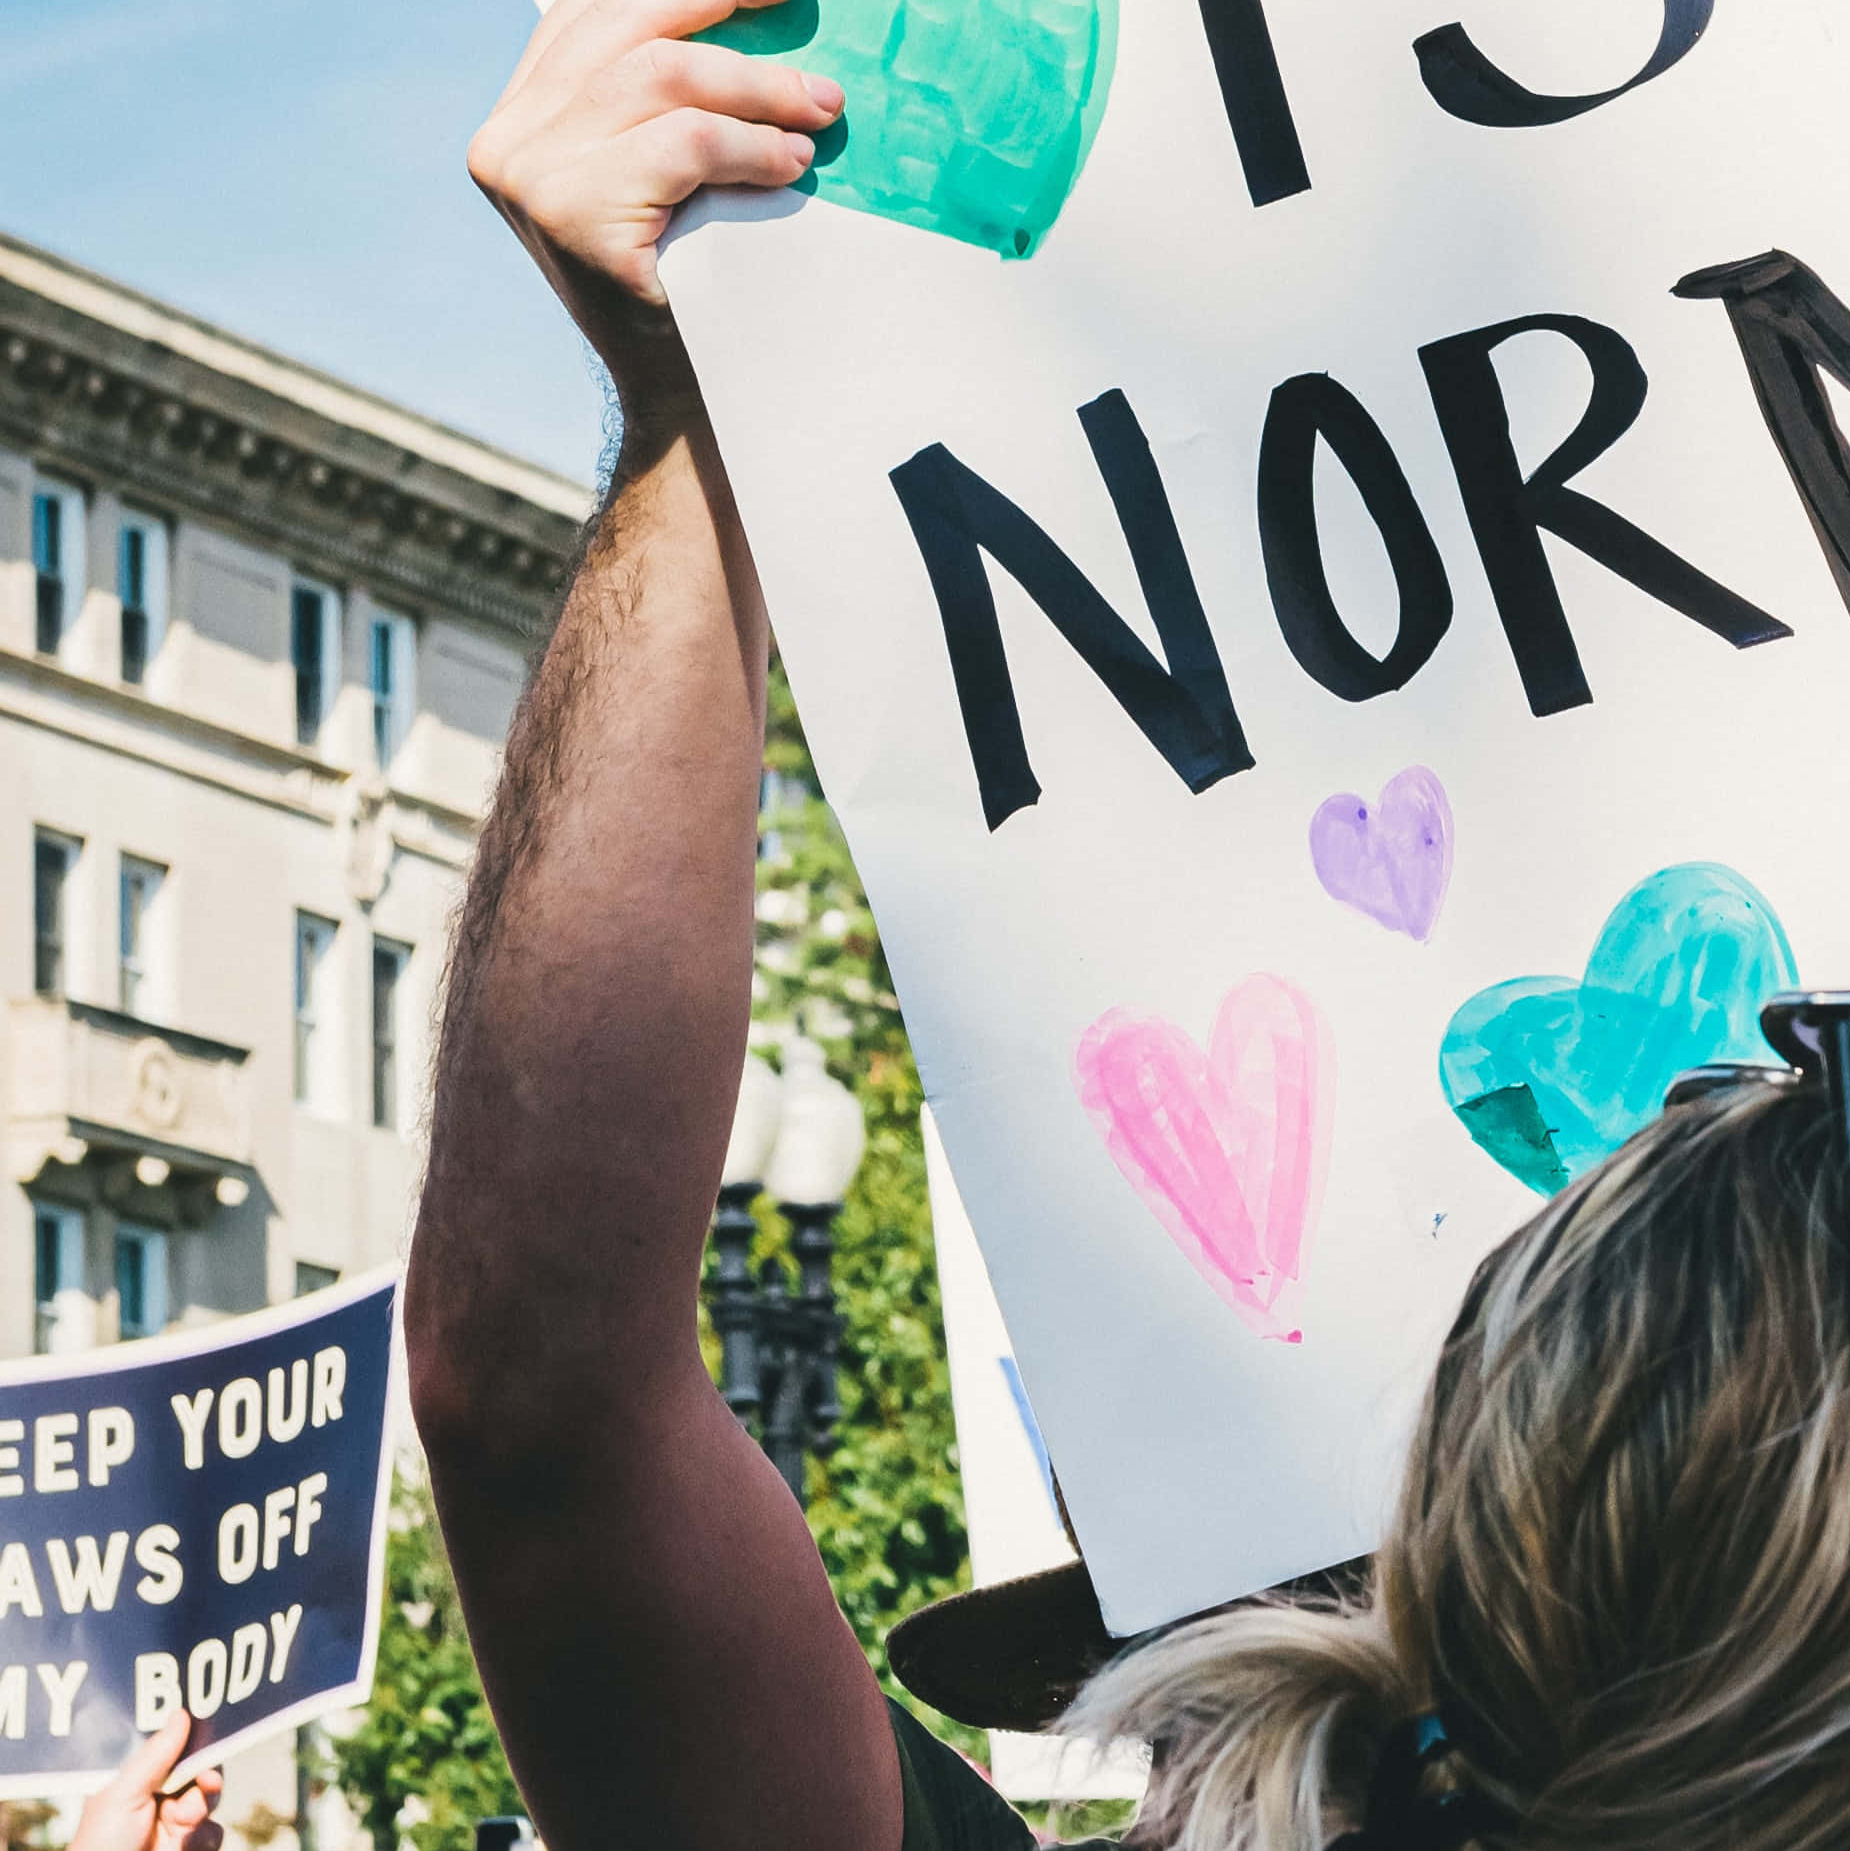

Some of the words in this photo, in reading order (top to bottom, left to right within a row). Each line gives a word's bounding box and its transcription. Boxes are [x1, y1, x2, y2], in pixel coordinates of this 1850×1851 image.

[171, 1346, 347, 1470] YOUR
[217, 1472, 328, 1585] OFF
[135, 1603, 303, 1734] BODY
